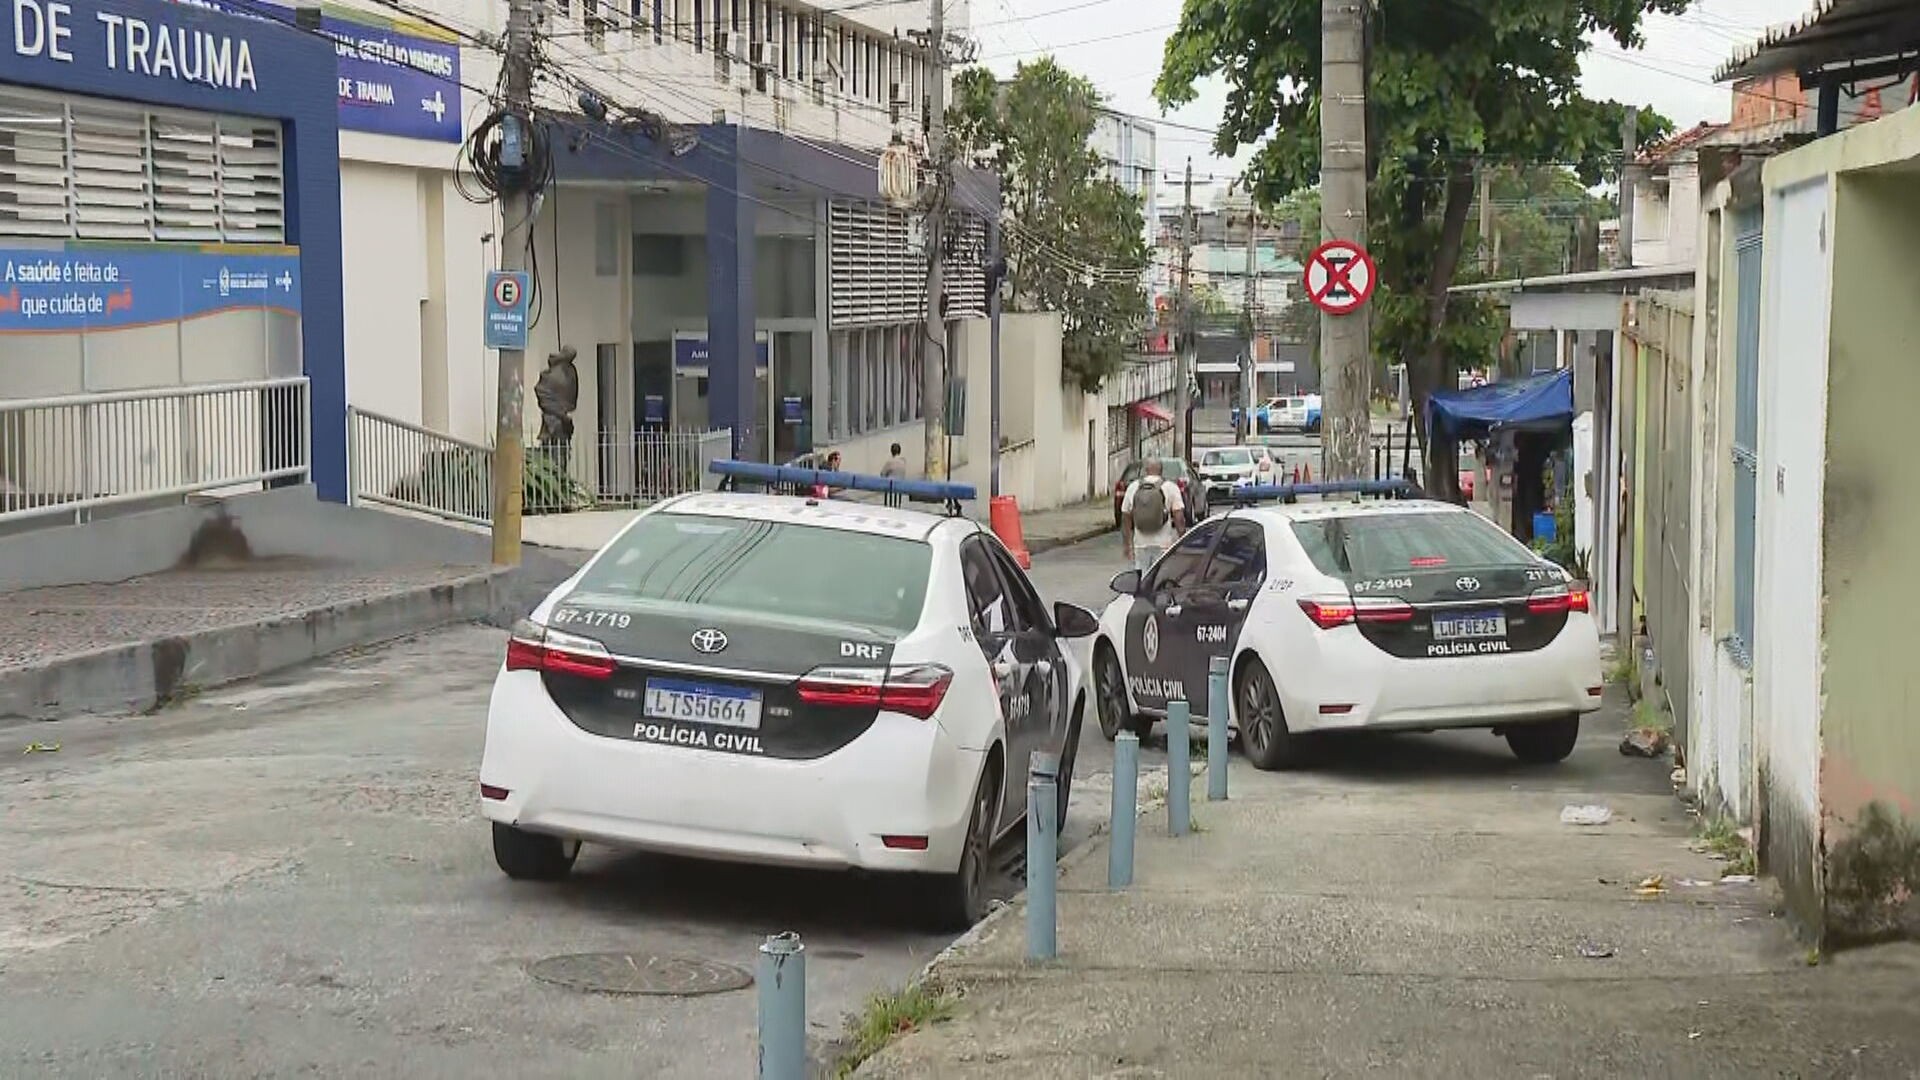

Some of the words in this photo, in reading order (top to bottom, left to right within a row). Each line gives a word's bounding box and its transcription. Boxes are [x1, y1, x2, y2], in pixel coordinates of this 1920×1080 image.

[12, 0, 73, 62] DE
[97, 12, 257, 92] TRAUMA
[409, 47, 453, 77] VARGAS
[339, 77, 352, 99] DE
[356, 80, 395, 105] TRAUMA
[5, 260, 16, 282] A
[18, 259, 60, 282] saúde
[63, 261, 72, 282] é
[74, 261, 101, 282] feita
[103, 261, 119, 282] de
[503, 282, 513, 302] E
[21, 296, 47, 318] que
[50, 291, 86, 313] cuida
[88, 292, 103, 312] de
[1354, 577, 1413, 593] 67-2404
[555, 608, 631, 629] 67-1719
[1440, 619, 1498, 636] LUF8E23
[1196, 625, 1227, 642] 67-2404
[840, 641, 884, 660] DRF
[1428, 642, 1476, 656] POLÍCIA
[1478, 640, 1511, 653] CIVIL
[1129, 673, 1163, 698] POLÍCIA
[1163, 680, 1187, 700] CIVIL
[655, 691, 746, 723] LTS5G64
[633, 722, 709, 748] POLÍCIA
[714, 732, 764, 754] CIVIL
